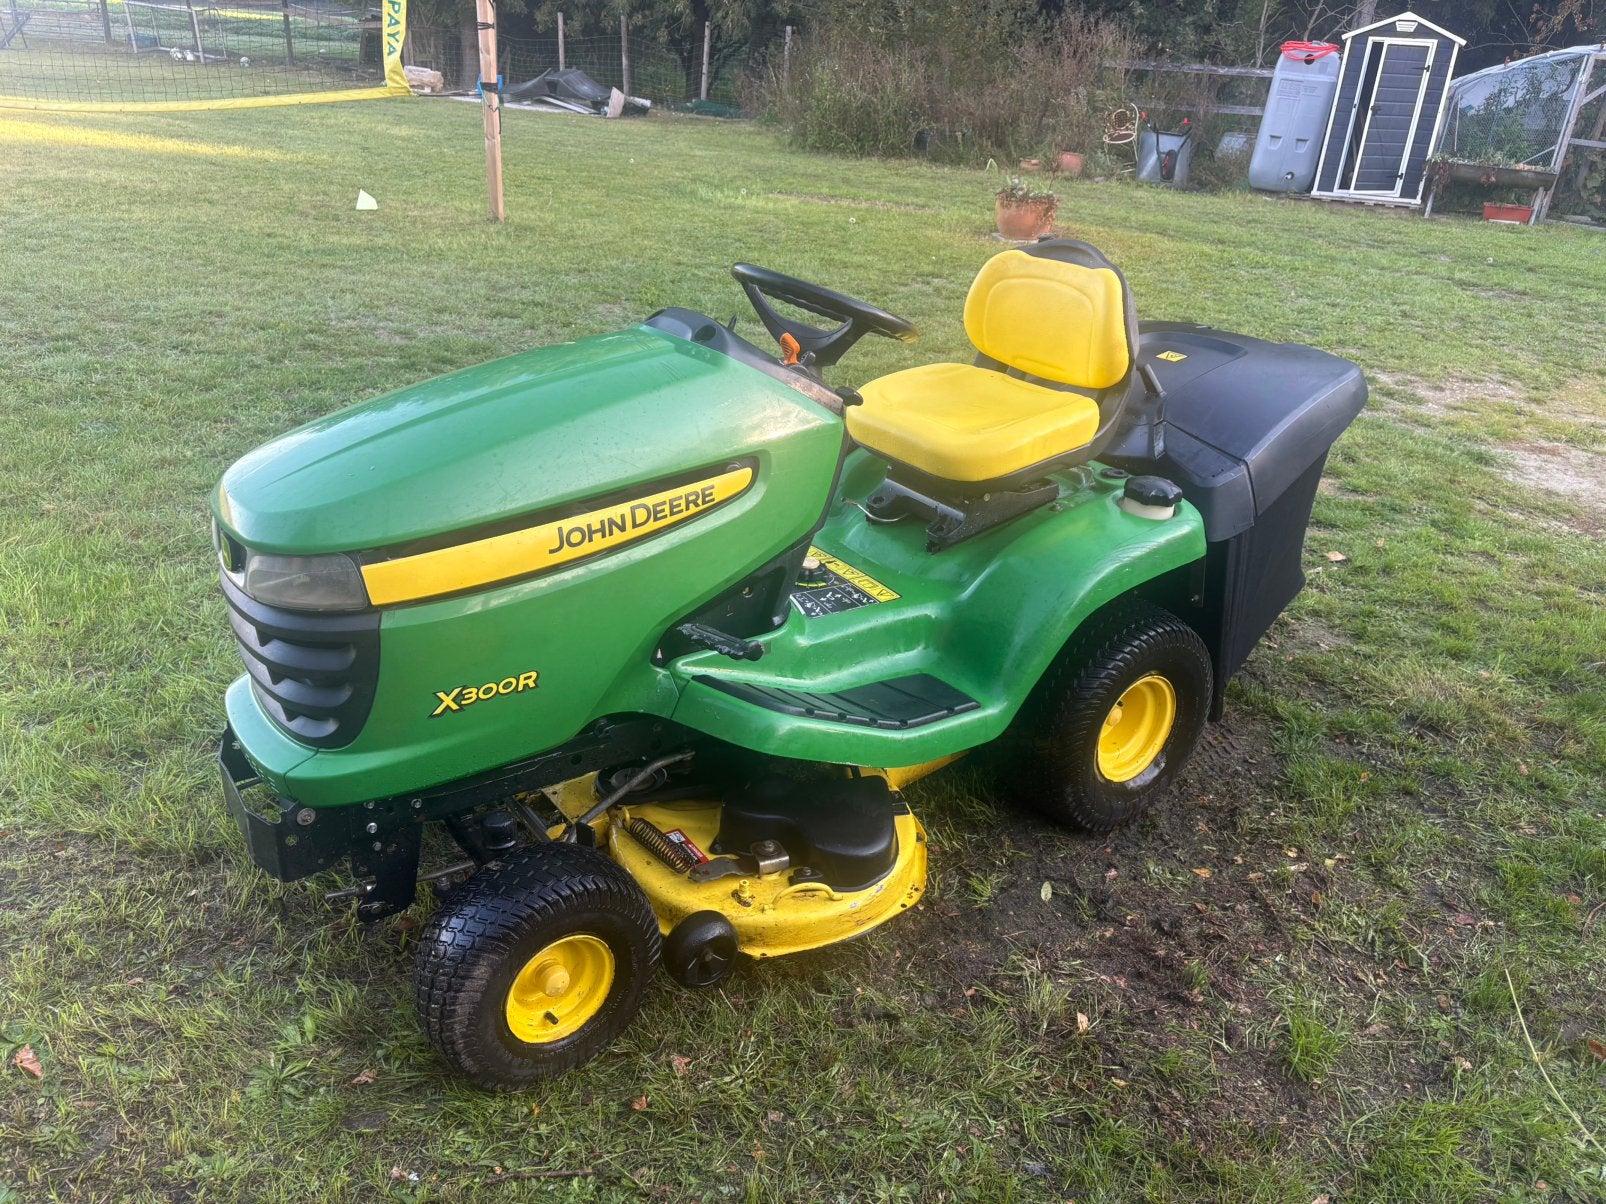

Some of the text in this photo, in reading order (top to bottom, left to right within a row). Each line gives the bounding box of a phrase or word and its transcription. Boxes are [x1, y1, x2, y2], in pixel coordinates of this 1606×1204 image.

[387, 0, 401, 56] PAYA
[549, 485, 715, 554] JOHN DEERE
[429, 670, 539, 717] X300R
